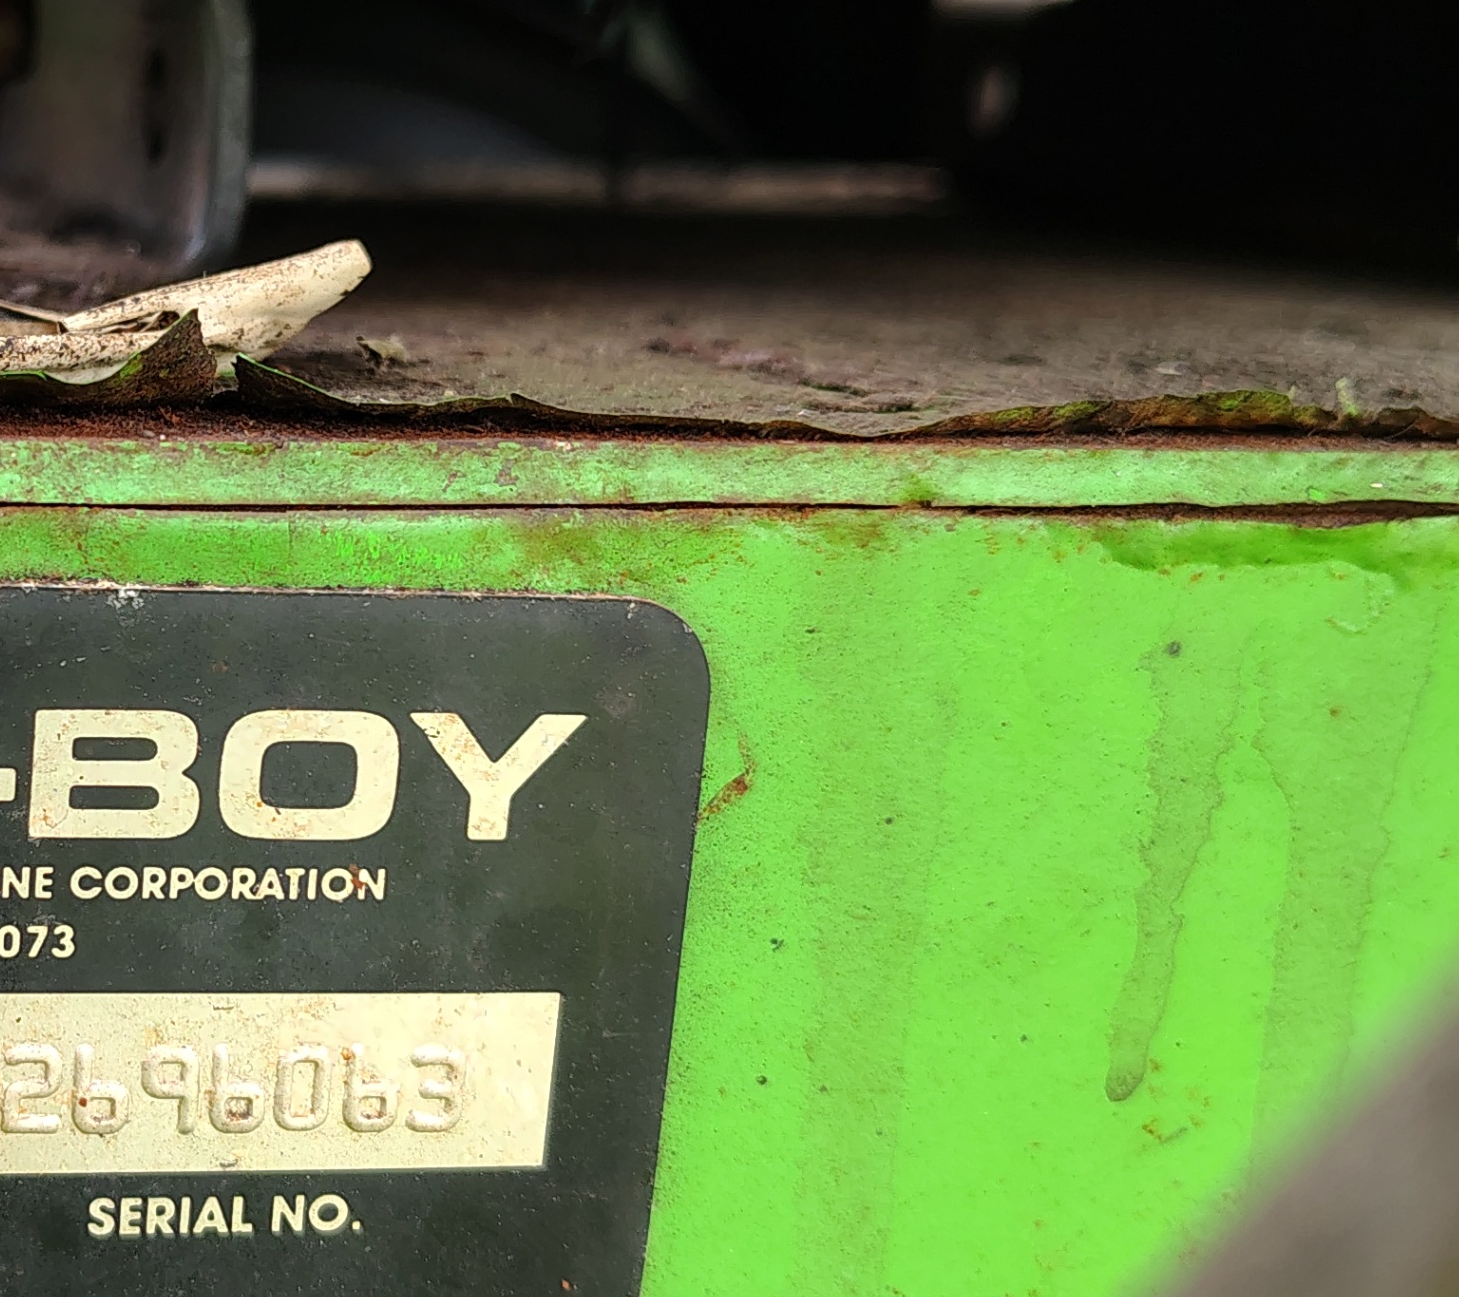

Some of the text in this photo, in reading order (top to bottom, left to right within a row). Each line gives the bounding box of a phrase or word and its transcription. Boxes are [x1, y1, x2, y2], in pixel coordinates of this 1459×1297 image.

[69, 866, 387, 902] CORPORATION
[87, 1193, 362, 1238] SERIAL NO.
